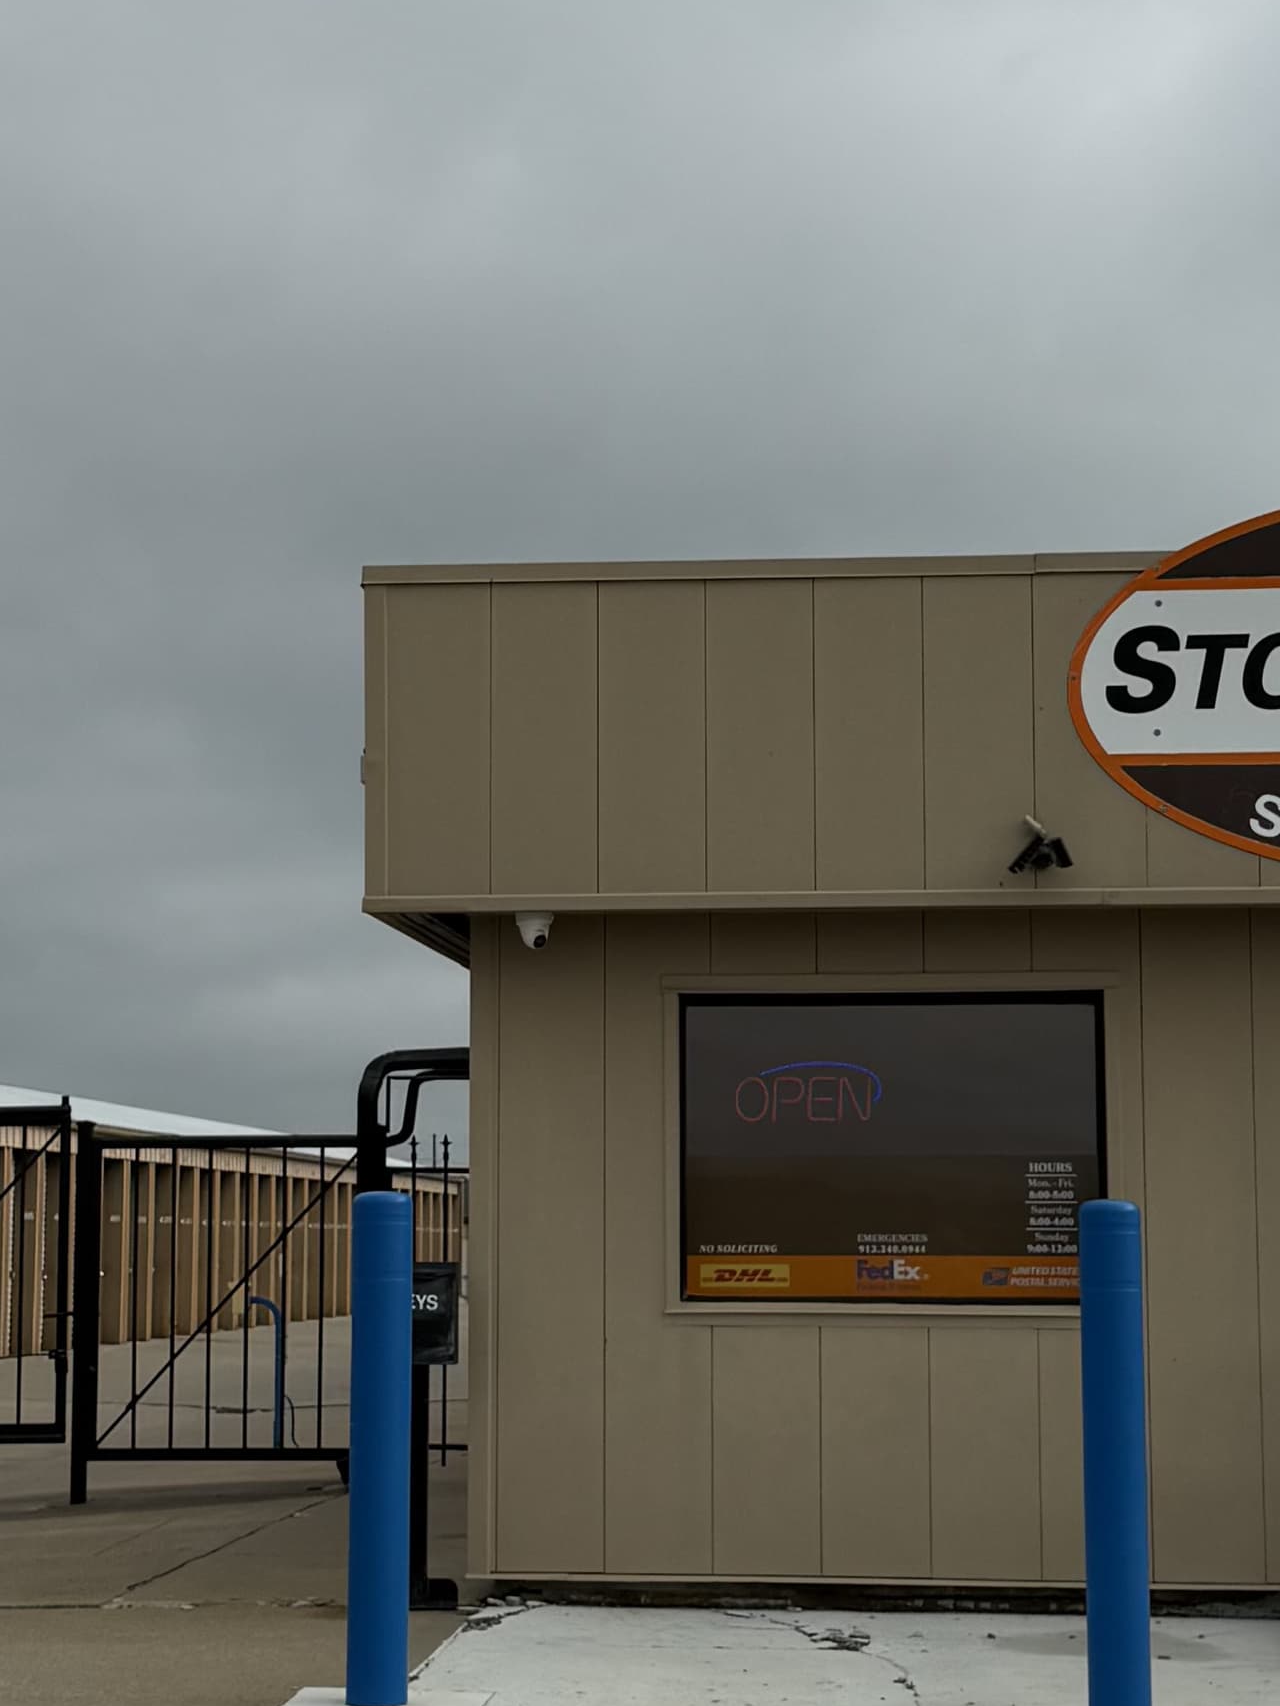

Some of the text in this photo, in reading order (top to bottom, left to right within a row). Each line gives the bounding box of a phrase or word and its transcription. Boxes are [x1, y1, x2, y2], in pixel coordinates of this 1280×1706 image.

[736, 1076, 872, 1122] OPEN
[1028, 1162, 1072, 1173] HOURS
[1030, 1205, 1072, 1216] Saturday
[856, 1233, 928, 1243] EMERGENCIES
[1034, 1232, 1069, 1243] Sunday
[700, 1244, 778, 1254] NO SOLICITING
[857, 1259, 921, 1280] FedEx
[713, 1268, 775, 1283] DHL
